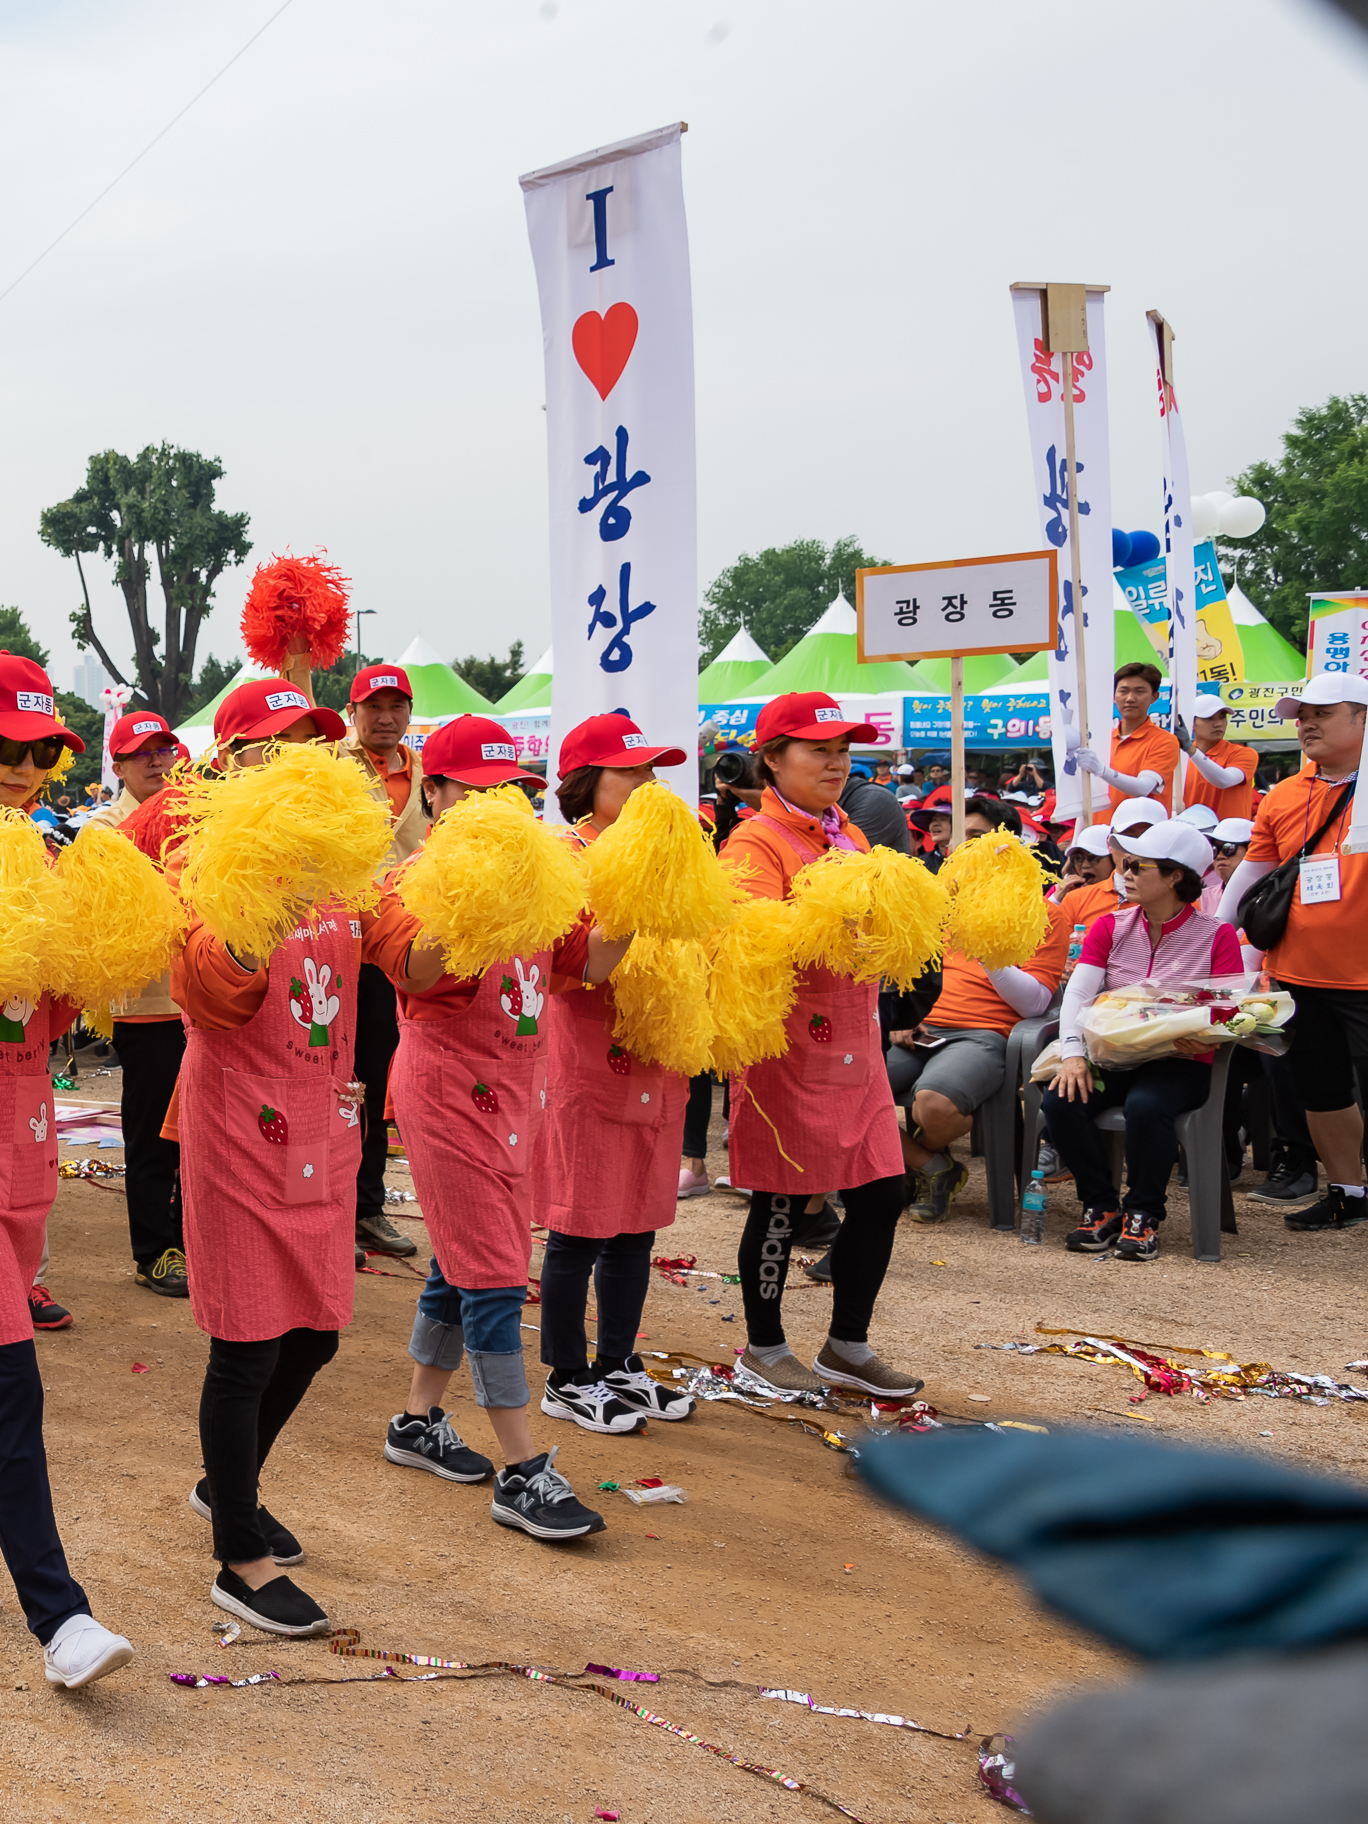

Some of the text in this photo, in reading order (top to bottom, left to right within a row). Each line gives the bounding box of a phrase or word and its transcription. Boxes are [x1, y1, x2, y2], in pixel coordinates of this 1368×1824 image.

[585, 185, 617, 273] I
[18, 694, 52, 713] 군자동
[268, 693, 308, 708] 군자동
[134, 722, 159, 733] 군자동
[483, 745, 514, 759] 군자동
[759, 1193, 792, 1300] adidas
